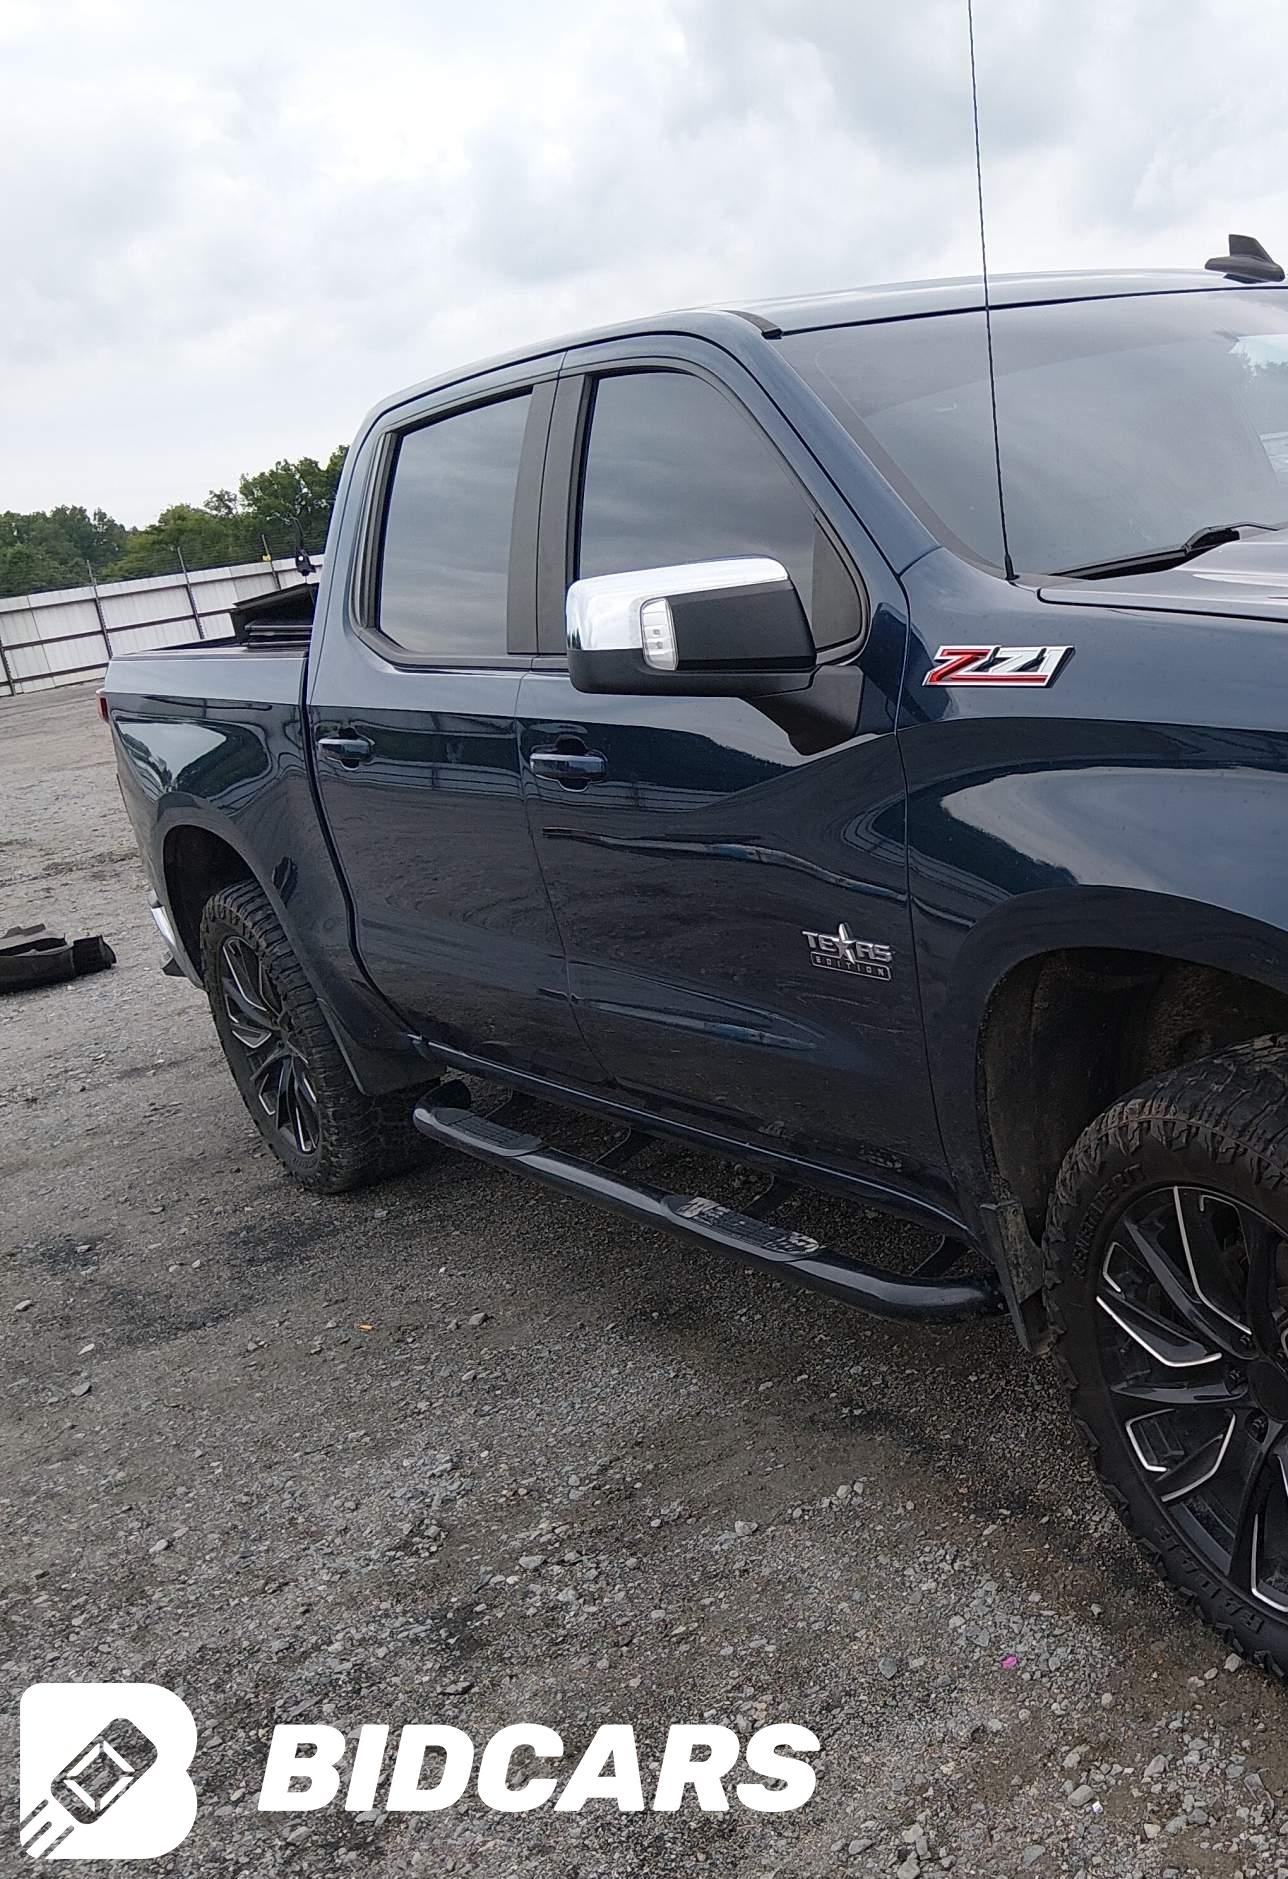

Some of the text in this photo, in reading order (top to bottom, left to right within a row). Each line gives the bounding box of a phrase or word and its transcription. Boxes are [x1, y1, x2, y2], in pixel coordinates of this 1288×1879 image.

[922, 645, 1076, 688] Z71
[802, 923, 893, 963] TEXAS
[815, 955, 885, 976] EDITION
